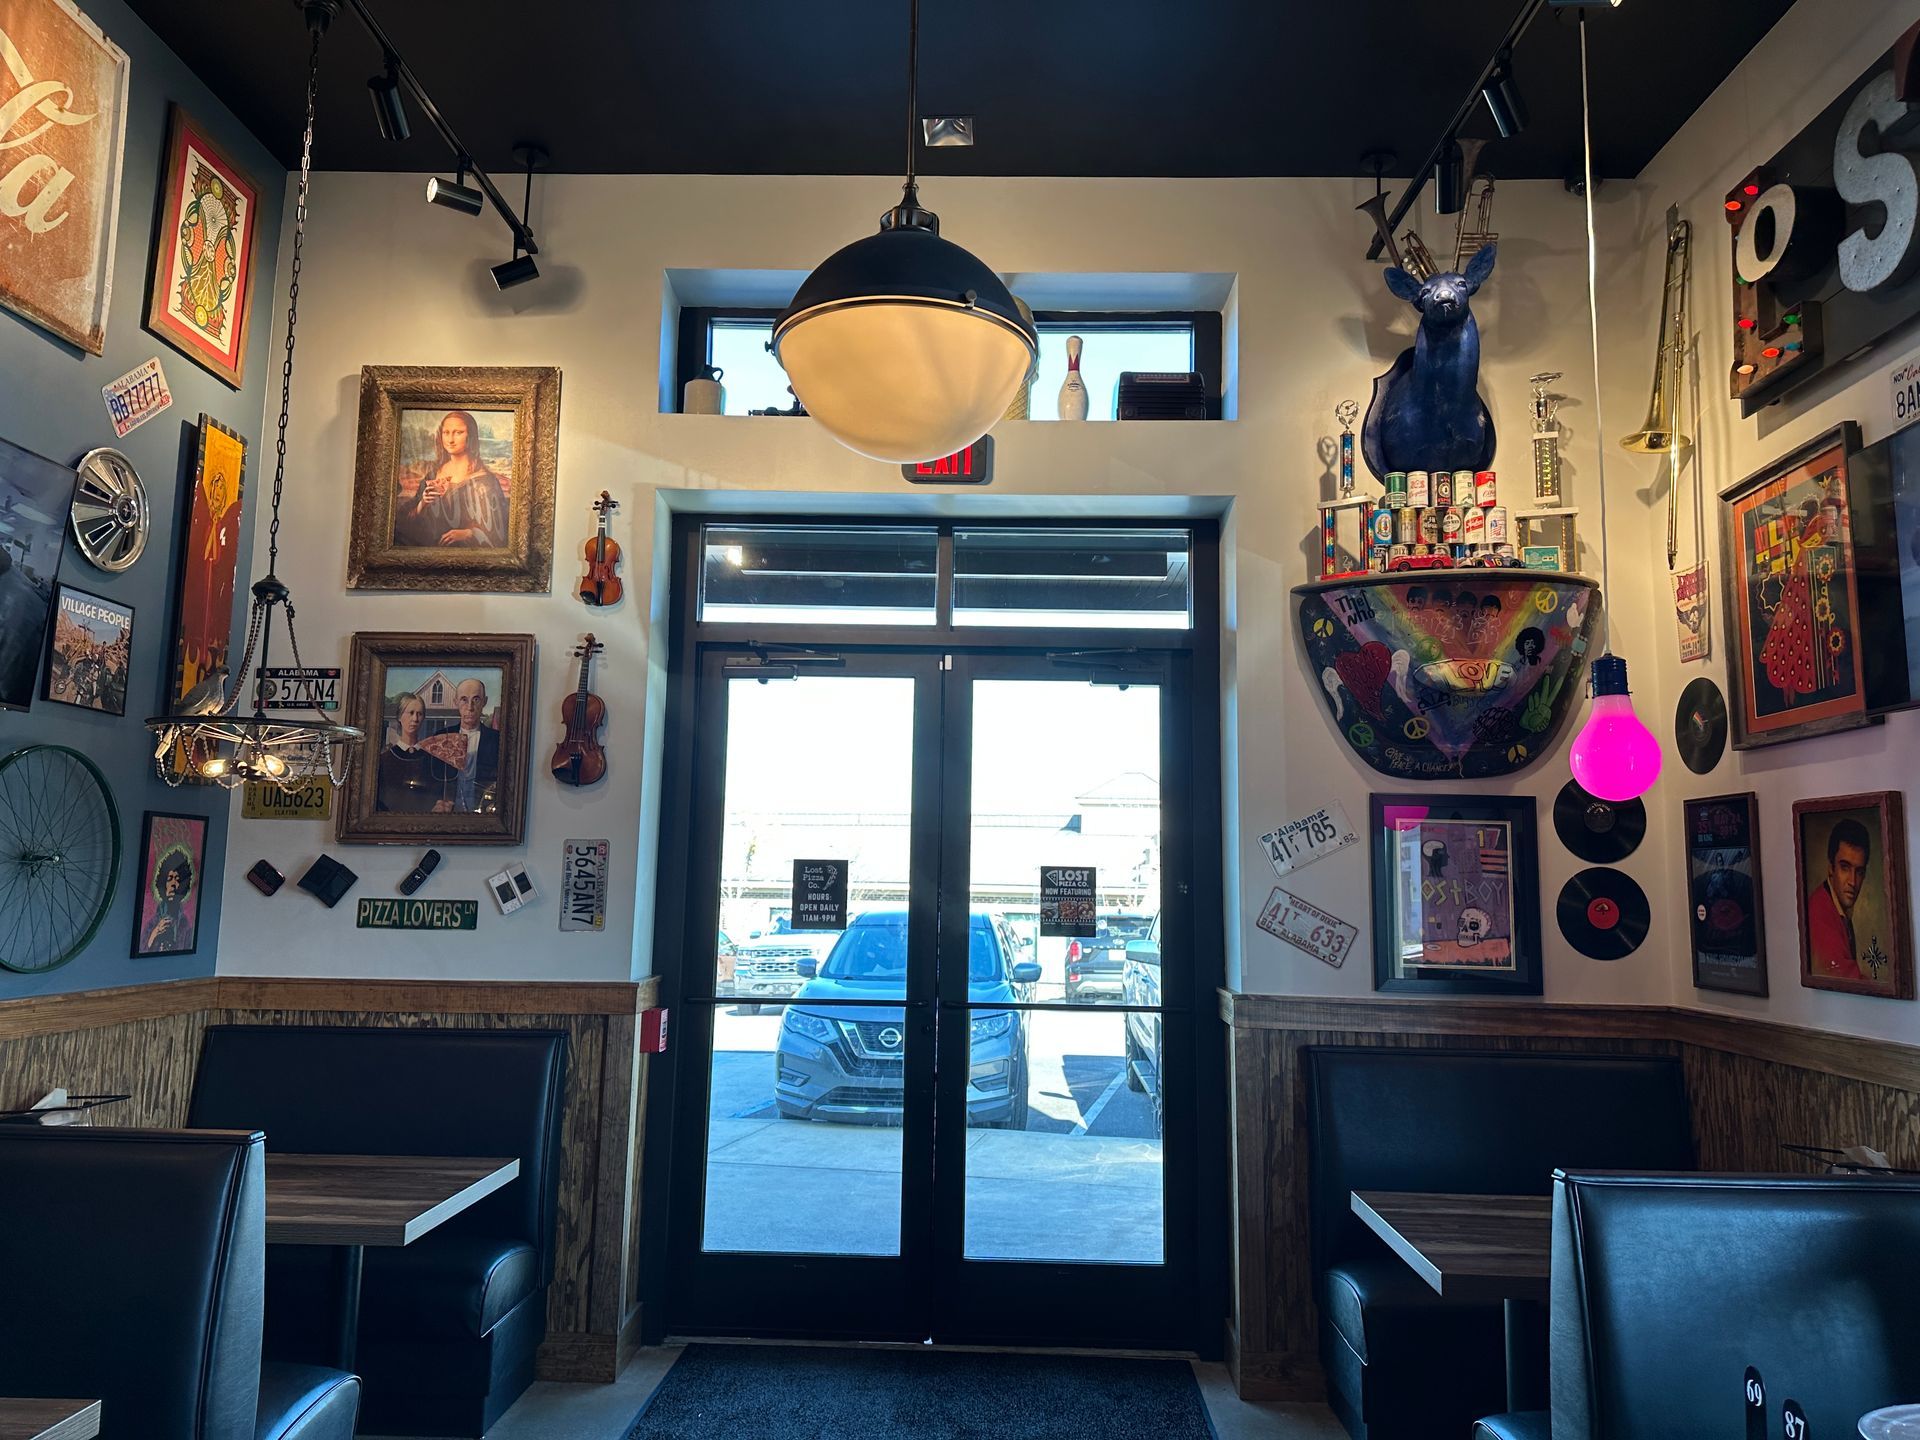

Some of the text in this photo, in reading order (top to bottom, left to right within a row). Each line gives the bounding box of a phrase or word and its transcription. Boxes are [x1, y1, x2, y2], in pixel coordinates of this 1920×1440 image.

[117, 367, 149, 390] ALABAMA
[61, 596, 96, 619] VILLAGE
[97, 608, 130, 630] PEOPLE
[278, 669, 319, 677] ALABAMA
[1277, 811, 1323, 837] Alabama
[1299, 816, 1337, 849] 785
[1476, 828, 1502, 849] 17
[803, 873, 825, 881] Pizza
[804, 866, 824, 874] Lost
[1058, 869, 1090, 881] LOST
[571, 846, 598, 926] 5645AN7
[807, 881, 820, 889] Co.
[1045, 887, 1092, 896] NOW FEATURING
[1464, 879, 1504, 904] BOY
[799, 903, 840, 912] OPEN DAILY
[807, 893, 832, 901] HOURS:
[360, 901, 476, 928] PIZZA LOVERS LN
[802, 914, 836, 922] 11AM-9PM
[1279, 929, 1321, 954] ALABAMA
[1784, 1410, 1806, 1440] 87
